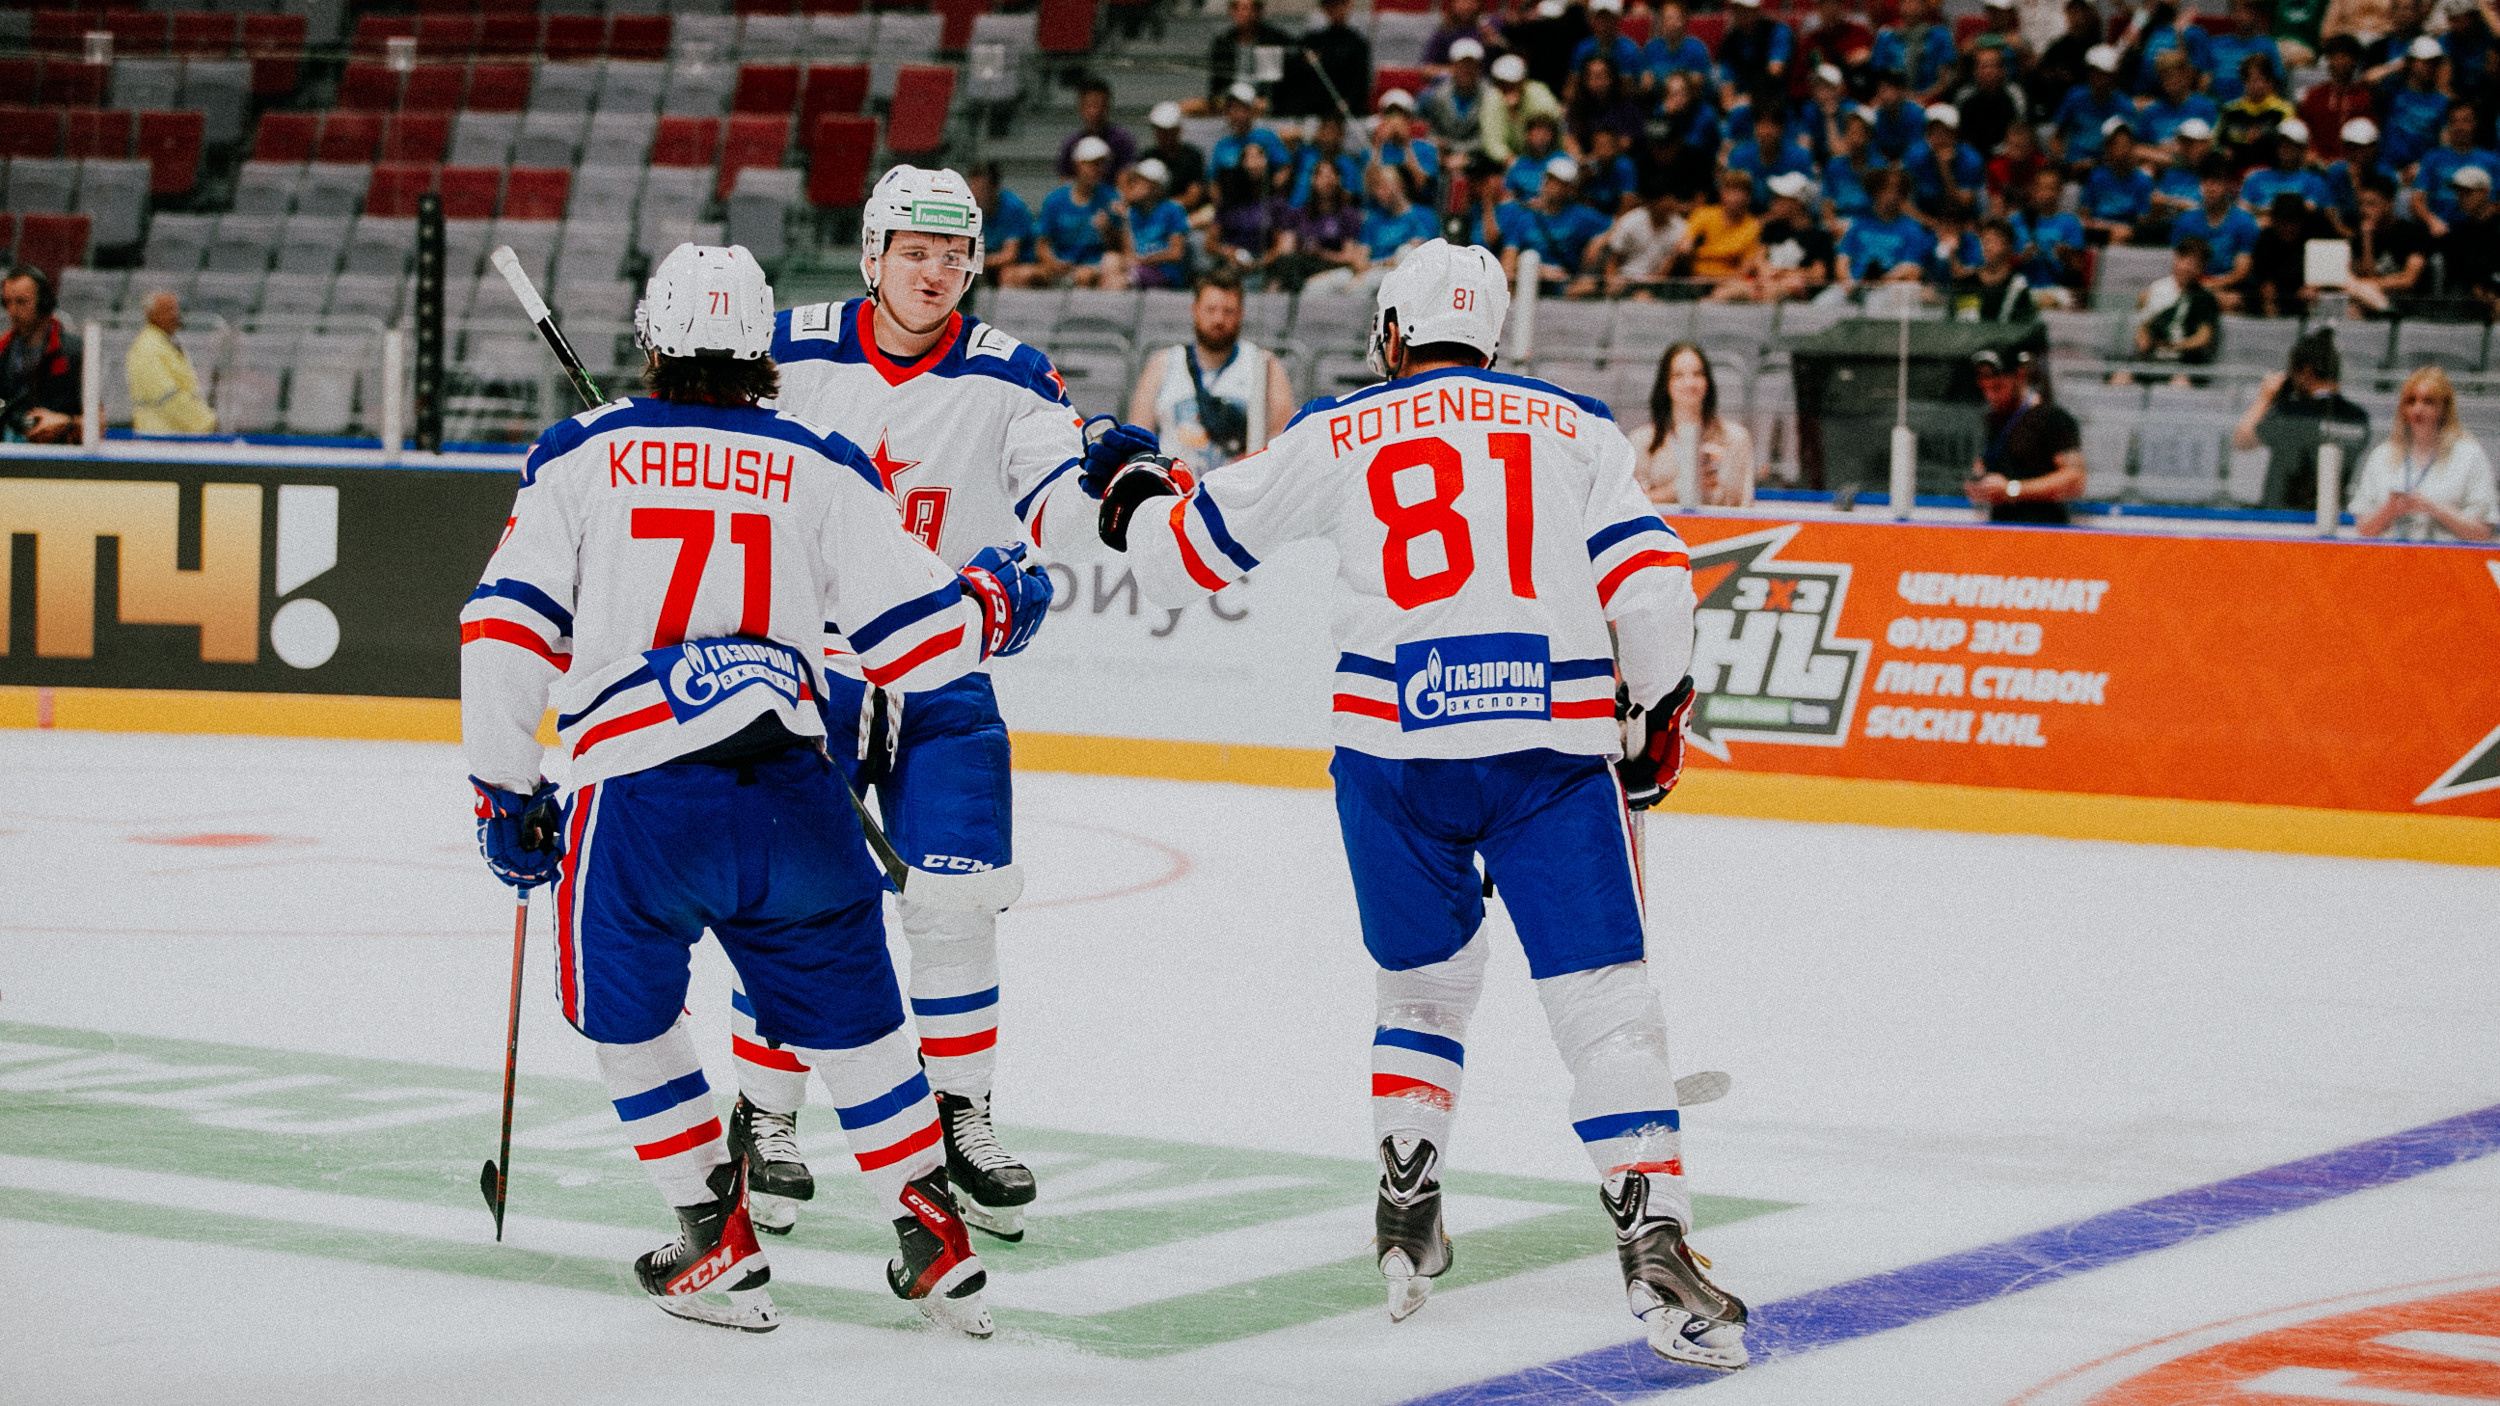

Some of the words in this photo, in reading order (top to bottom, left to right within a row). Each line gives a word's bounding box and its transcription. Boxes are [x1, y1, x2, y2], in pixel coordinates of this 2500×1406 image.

[709, 292, 728, 315] 71
[1453, 288, 1474, 311] 81
[1329, 387, 1576, 458] ROTENBERG
[609, 440, 794, 503] KABUSH
[1366, 432, 1537, 611] 81
[0, 477, 341, 669] ТЧ!
[631, 507, 771, 650] 71
[1897, 571, 2110, 614] ЧЕМПИОНАТ
[1886, 615, 1967, 651] ФХР
[704, 644, 795, 676] ГАЗПРОМ
[1690, 608, 1850, 700] HL
[1445, 661, 1544, 692] ГАЗПРОМ
[1873, 660, 1965, 698] ЛИГА
[1970, 665, 2110, 706] СТАВОК
[1450, 696, 1540, 712] ЭКСПОРТ
[1864, 704, 1975, 743] SOCHI
[922, 854, 994, 873] CCM
[908, 1194, 946, 1224] CCM
[669, 1244, 734, 1296] CCM
